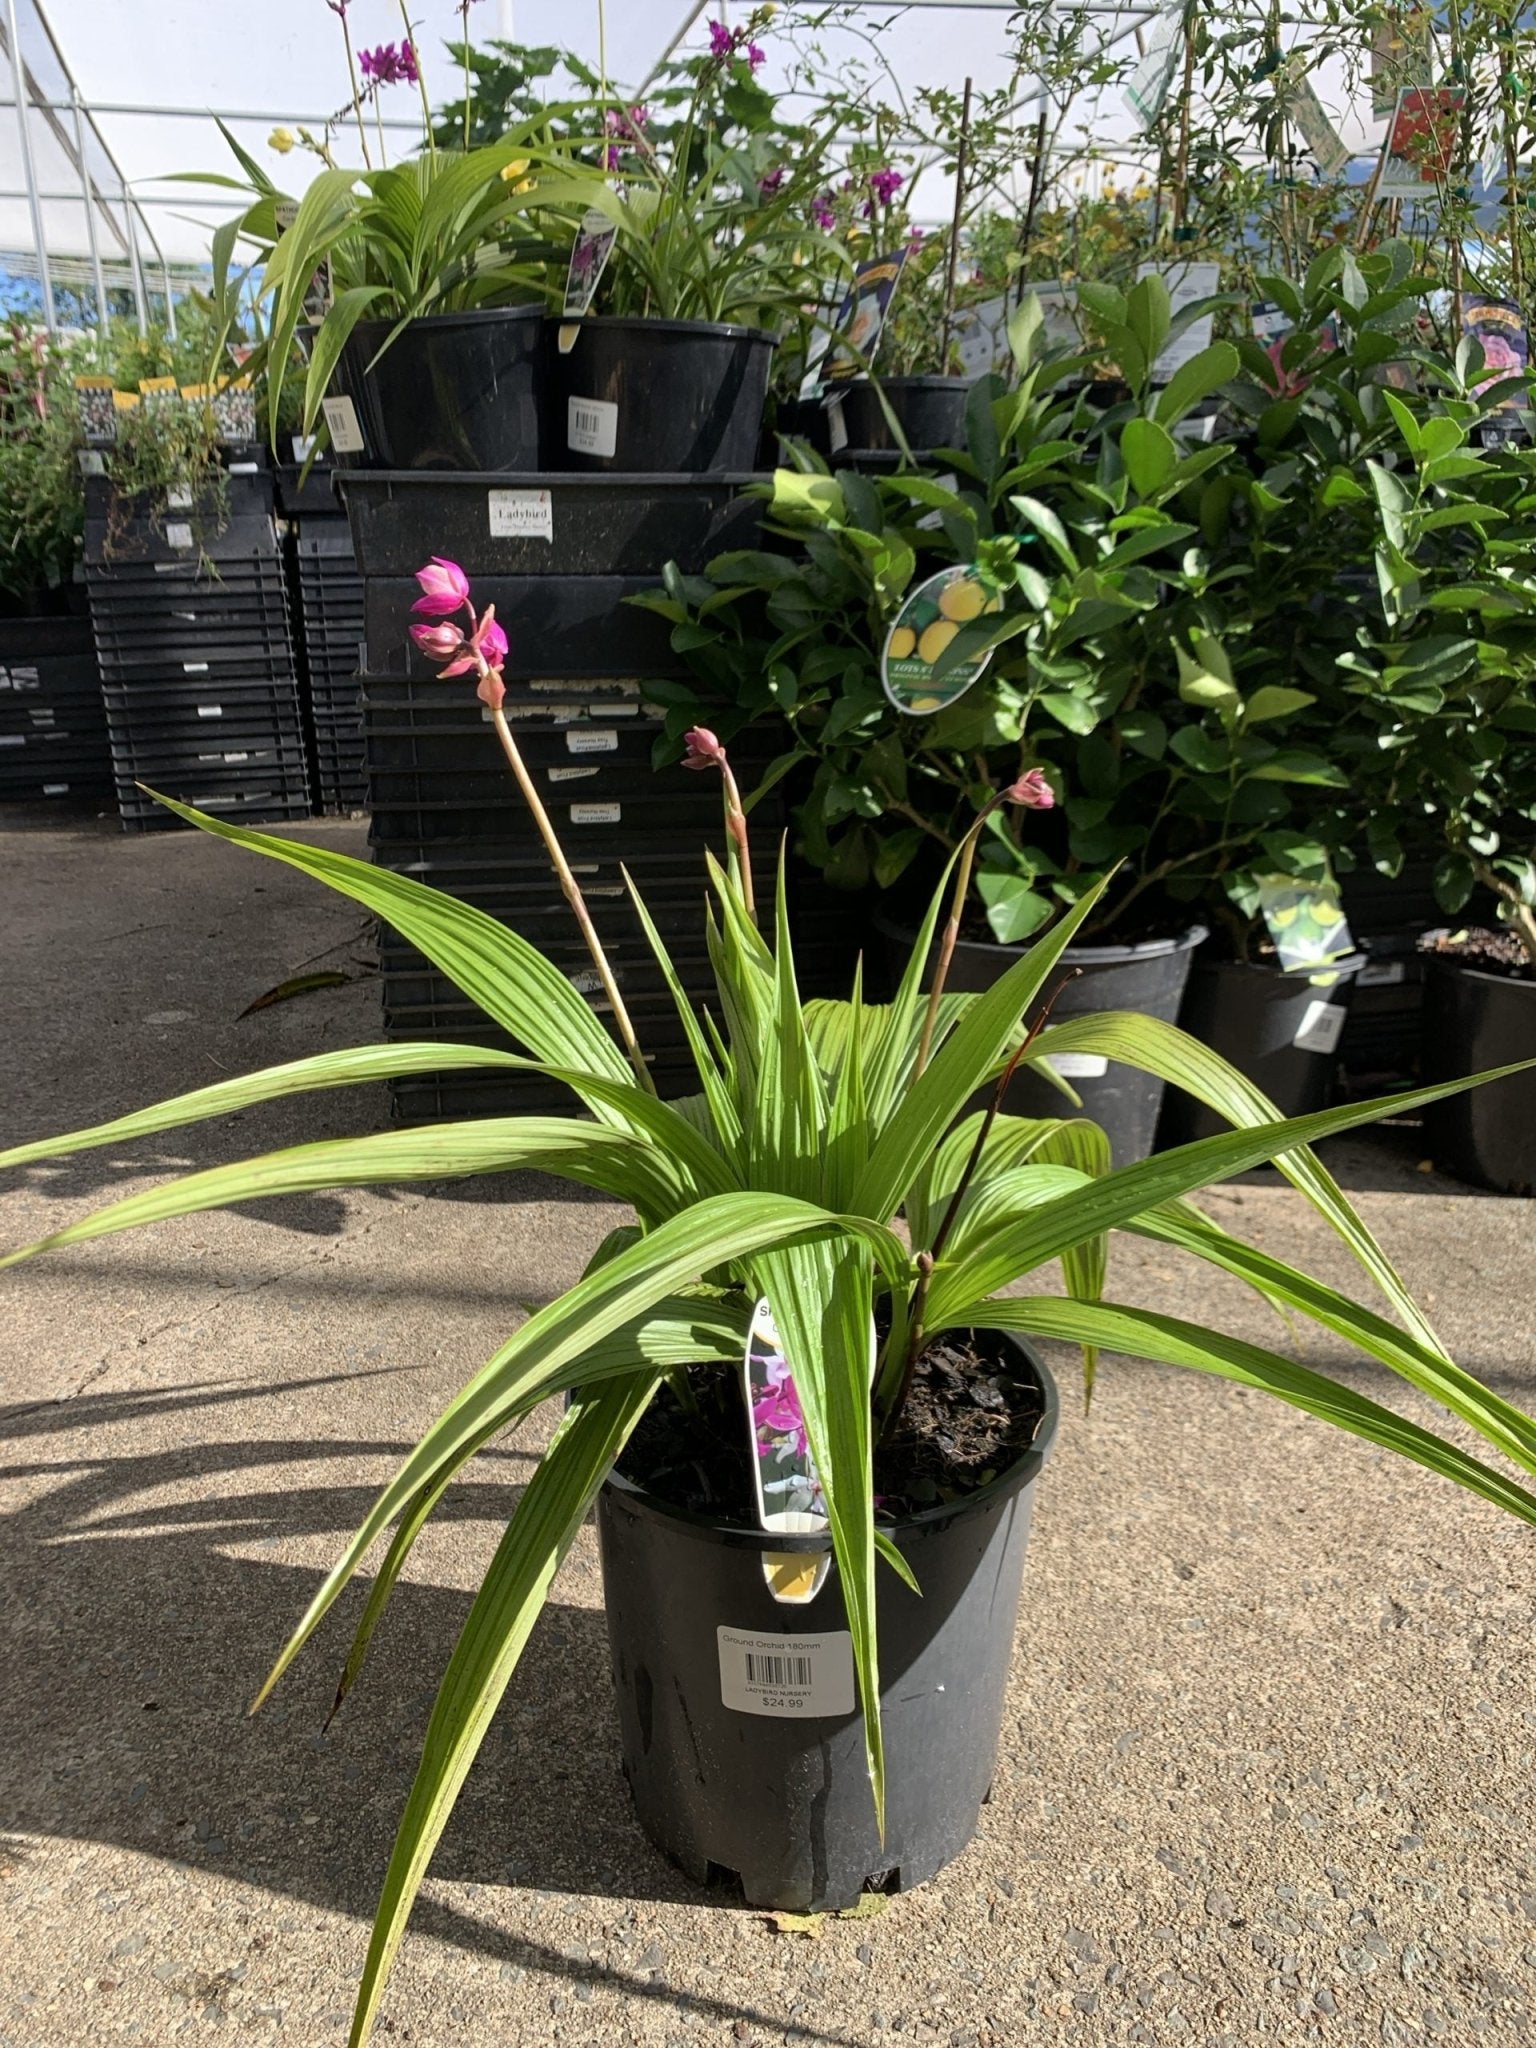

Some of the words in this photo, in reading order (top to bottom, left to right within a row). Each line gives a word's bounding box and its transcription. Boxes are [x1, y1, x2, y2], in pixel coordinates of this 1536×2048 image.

[499, 508, 547, 521] Ladybird
[722, 1634, 754, 1647] Ground
[756, 1640, 785, 1650] Orchid
[787, 1642, 821, 1650] 180mm
[745, 1687, 778, 1696] LADYBIRD
[762, 1697, 804, 1708] $24.99
